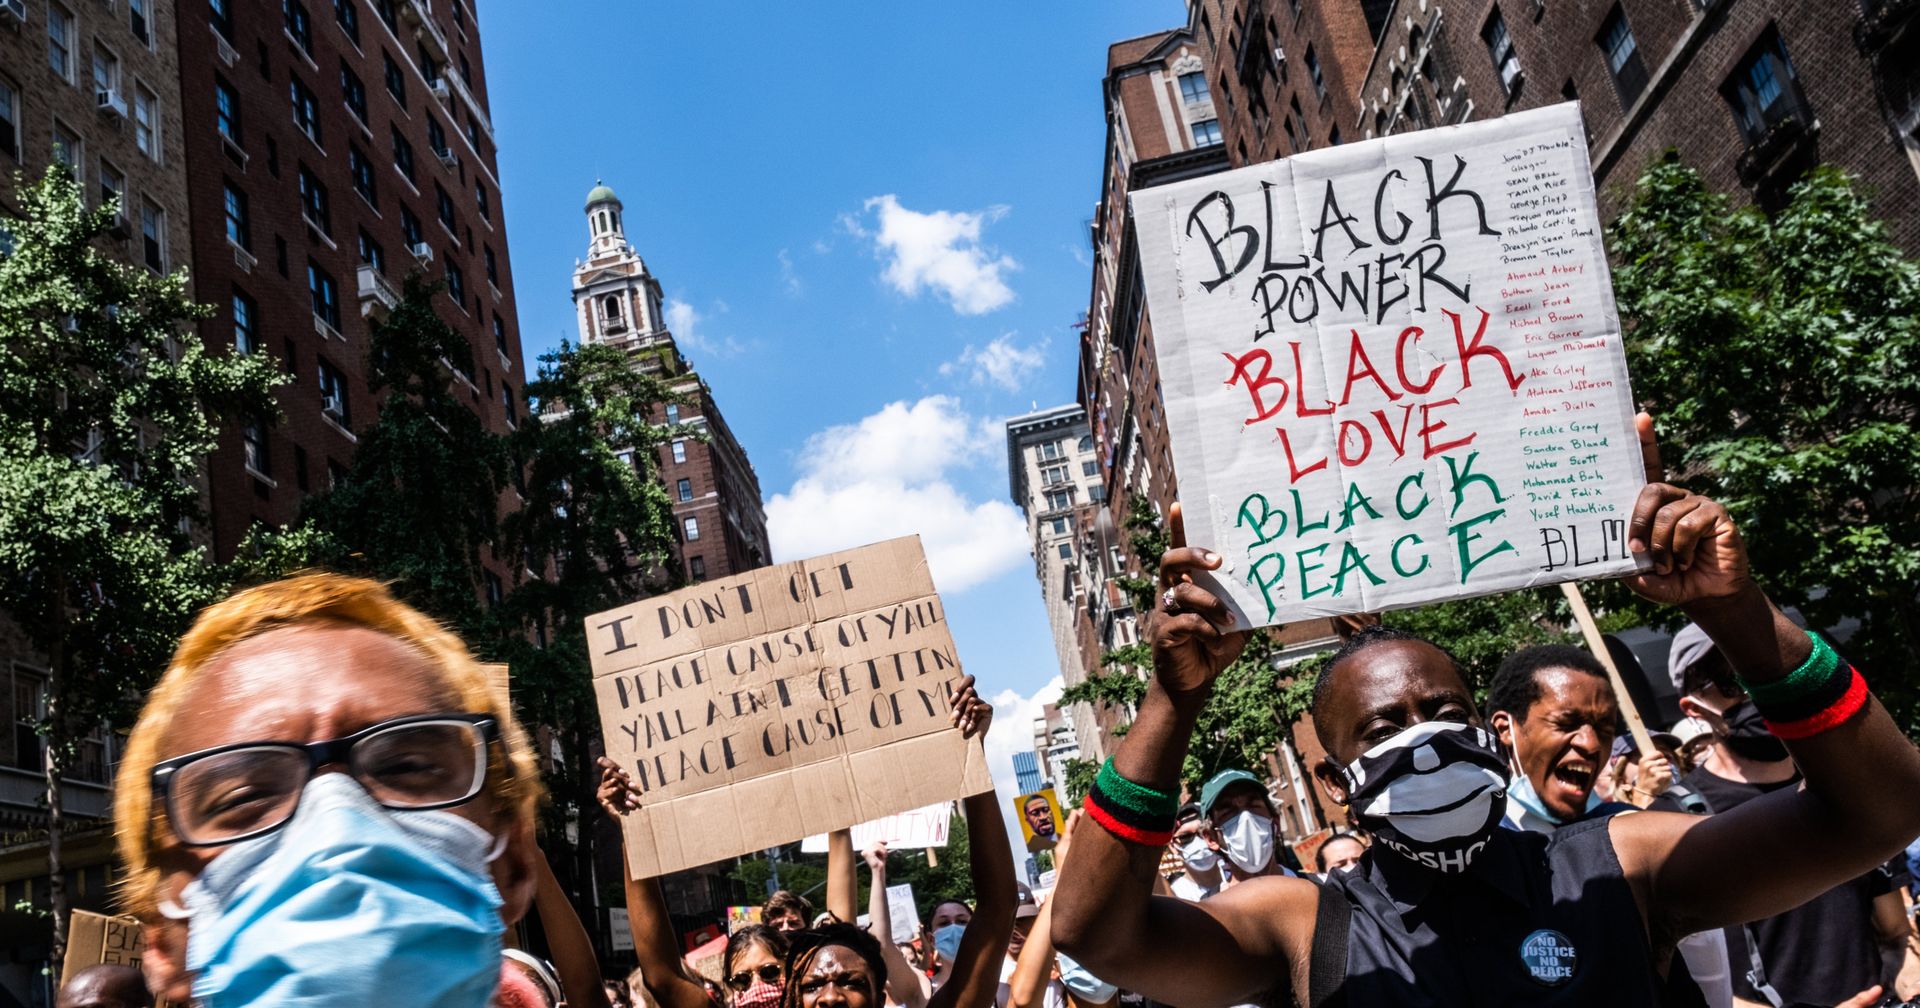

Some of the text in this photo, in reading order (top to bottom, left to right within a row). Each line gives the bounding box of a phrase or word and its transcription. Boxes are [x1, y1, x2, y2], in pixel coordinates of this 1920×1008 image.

[1185, 153, 1501, 293] BLACK
[1541, 247, 1575, 258] Taylor
[1551, 263, 1584, 275] Arbery
[1251, 243, 1471, 342] POWER
[1543, 282, 1569, 292] Jean
[1542, 296, 1571, 308] Ford
[1510, 311, 1584, 328] Michael Brown
[1524, 330, 1583, 344] Eric Garner
[1223, 306, 1526, 425] BLACK
[1530, 367, 1548, 378] Akai
[1568, 379, 1612, 391] Jefferson
[1520, 421, 1599, 438] Freddie Gray
[1276, 398, 1477, 484] LOVE
[1523, 437, 1608, 455] Sandra Bland
[1526, 454, 1598, 470] Walter Scott
[1579, 470, 1604, 482] Bah
[1234, 451, 1506, 549] BLACK
[1527, 487, 1602, 502] David Felix
[1529, 505, 1559, 521] Yusef
[1539, 519, 1629, 571] BLM
[1247, 509, 1515, 622] PEACE
[597, 560, 853, 655] I DON'T GET
[615, 600, 944, 709] PEACE CAUSE OF Y'ALL
[620, 708, 697, 753] Y'ALL
[818, 644, 956, 702] GETTIN
[636, 733, 748, 792] PEACE
[762, 703, 860, 757] CAUSE
[869, 691, 905, 729] OF
[1538, 936, 1556, 947] NO
[1524, 946, 1576, 957] JUSTICE
[1540, 956, 1558, 967] NO
[1531, 966, 1572, 977] PEACE
